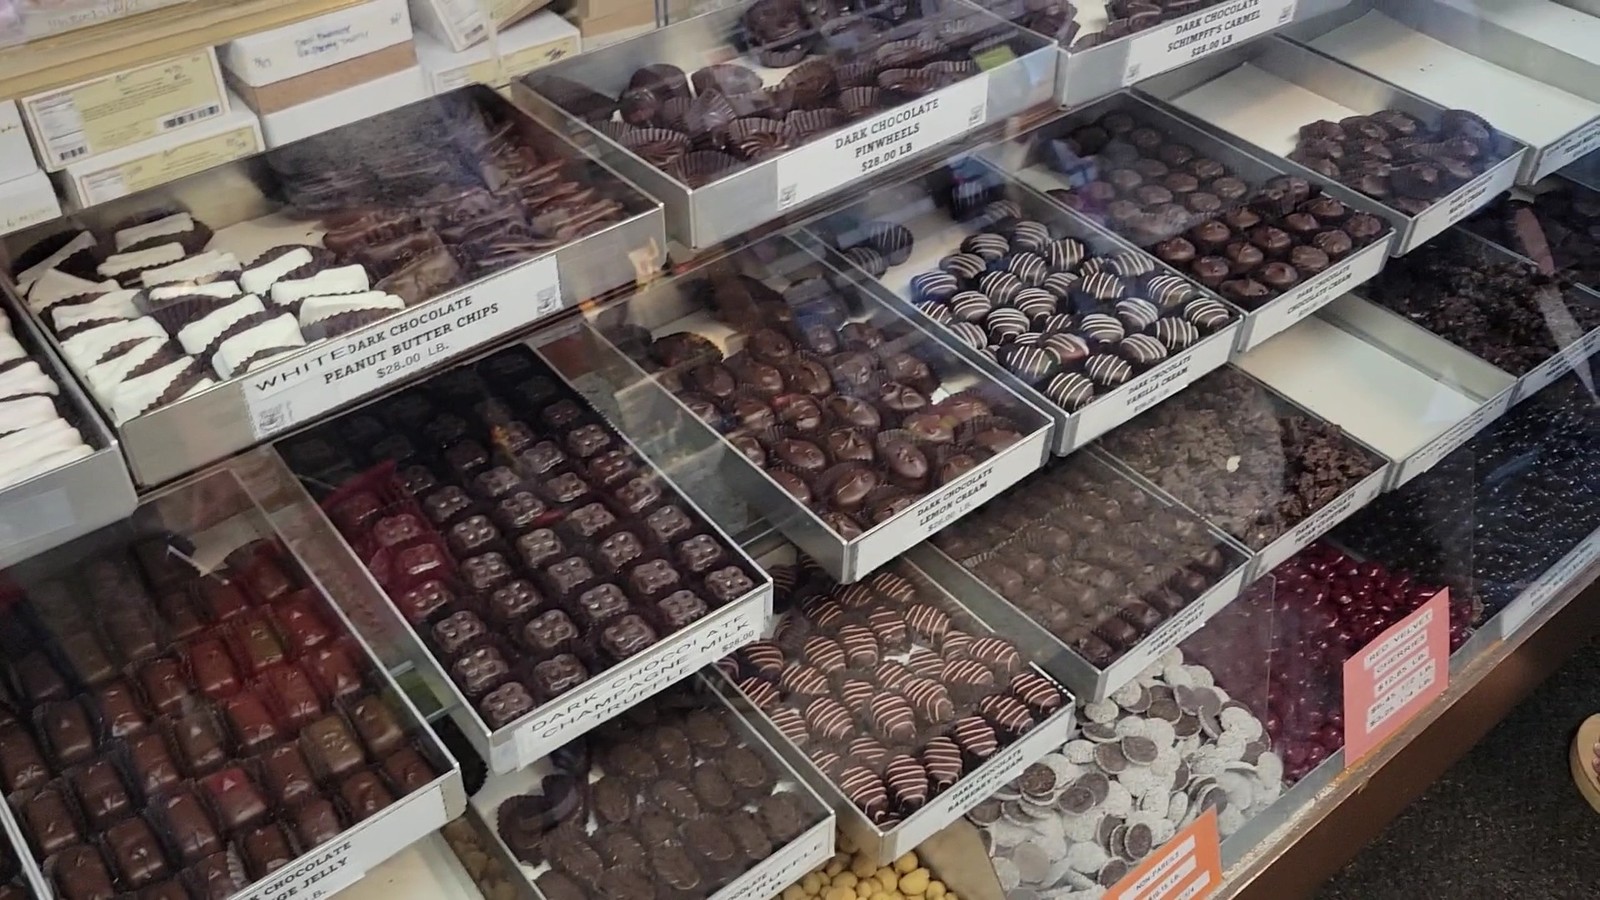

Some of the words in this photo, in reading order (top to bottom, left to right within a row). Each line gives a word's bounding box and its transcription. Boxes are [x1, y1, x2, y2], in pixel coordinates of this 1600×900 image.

[1175, 17, 1202, 35] DARK
[835, 128, 868, 149] DARK
[871, 98, 939, 135] CHOCOLATE
[855, 122, 921, 158] PINWHEELS
[862, 150, 896, 172] $28.00
[899, 143, 913, 159] LB
[256, 346, 346, 391] WHITE
[348, 331, 386, 354] DARK
[389, 296, 473, 337] CHOCOLATE
[324, 352, 389, 384] PEANUT
[393, 327, 452, 356] BUTTER
[457, 303, 500, 329] CHIPS
[376, 353, 421, 379] $28.00
[428, 342, 450, 357] LB.
[1161, 366, 1188, 386] CREAM
[917, 498, 941, 516] DARK
[943, 467, 993, 501] CHOCOLATE
[920, 501, 953, 526] LEMON
[955, 480, 988, 504] CREAM
[1394, 612, 1432, 642] VELVET
[532, 692, 598, 732] DARK
[612, 613, 745, 689] CHOCOLATE
[1376, 634, 1425, 673] CHERRIES
[542, 654, 690, 738] CHAMPAGNE
[701, 620, 750, 652] MILK
[592, 664, 691, 720] TRUFFLE
[264, 841, 352, 895] CHOCOLATE
[302, 856, 348, 889] JELLY
